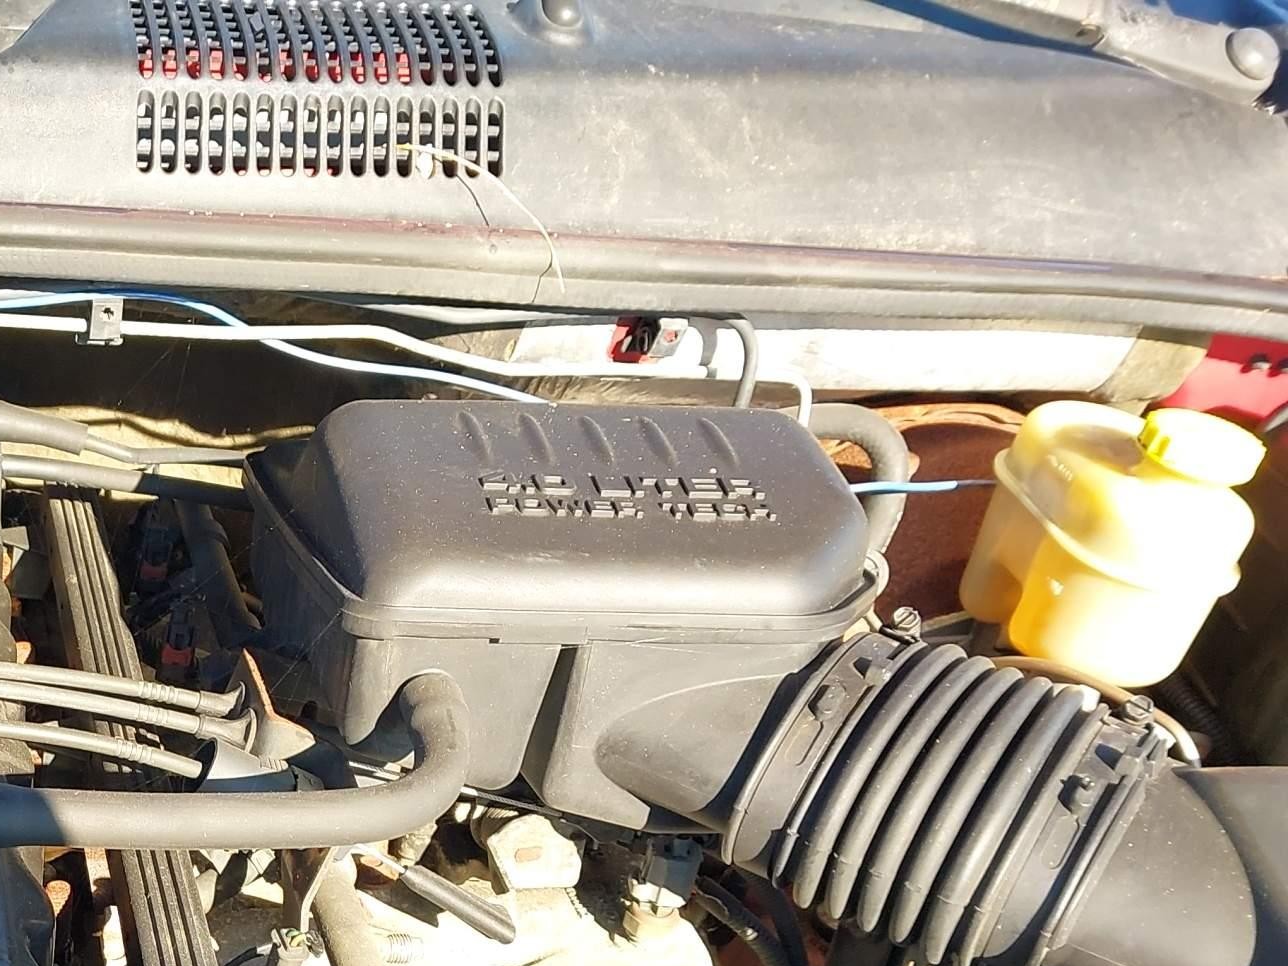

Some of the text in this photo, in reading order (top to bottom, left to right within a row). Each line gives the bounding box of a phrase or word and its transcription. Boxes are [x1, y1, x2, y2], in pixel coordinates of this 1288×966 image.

[477, 468, 767, 501] 4.0 LITER
[484, 496, 777, 522] POWER TECH
